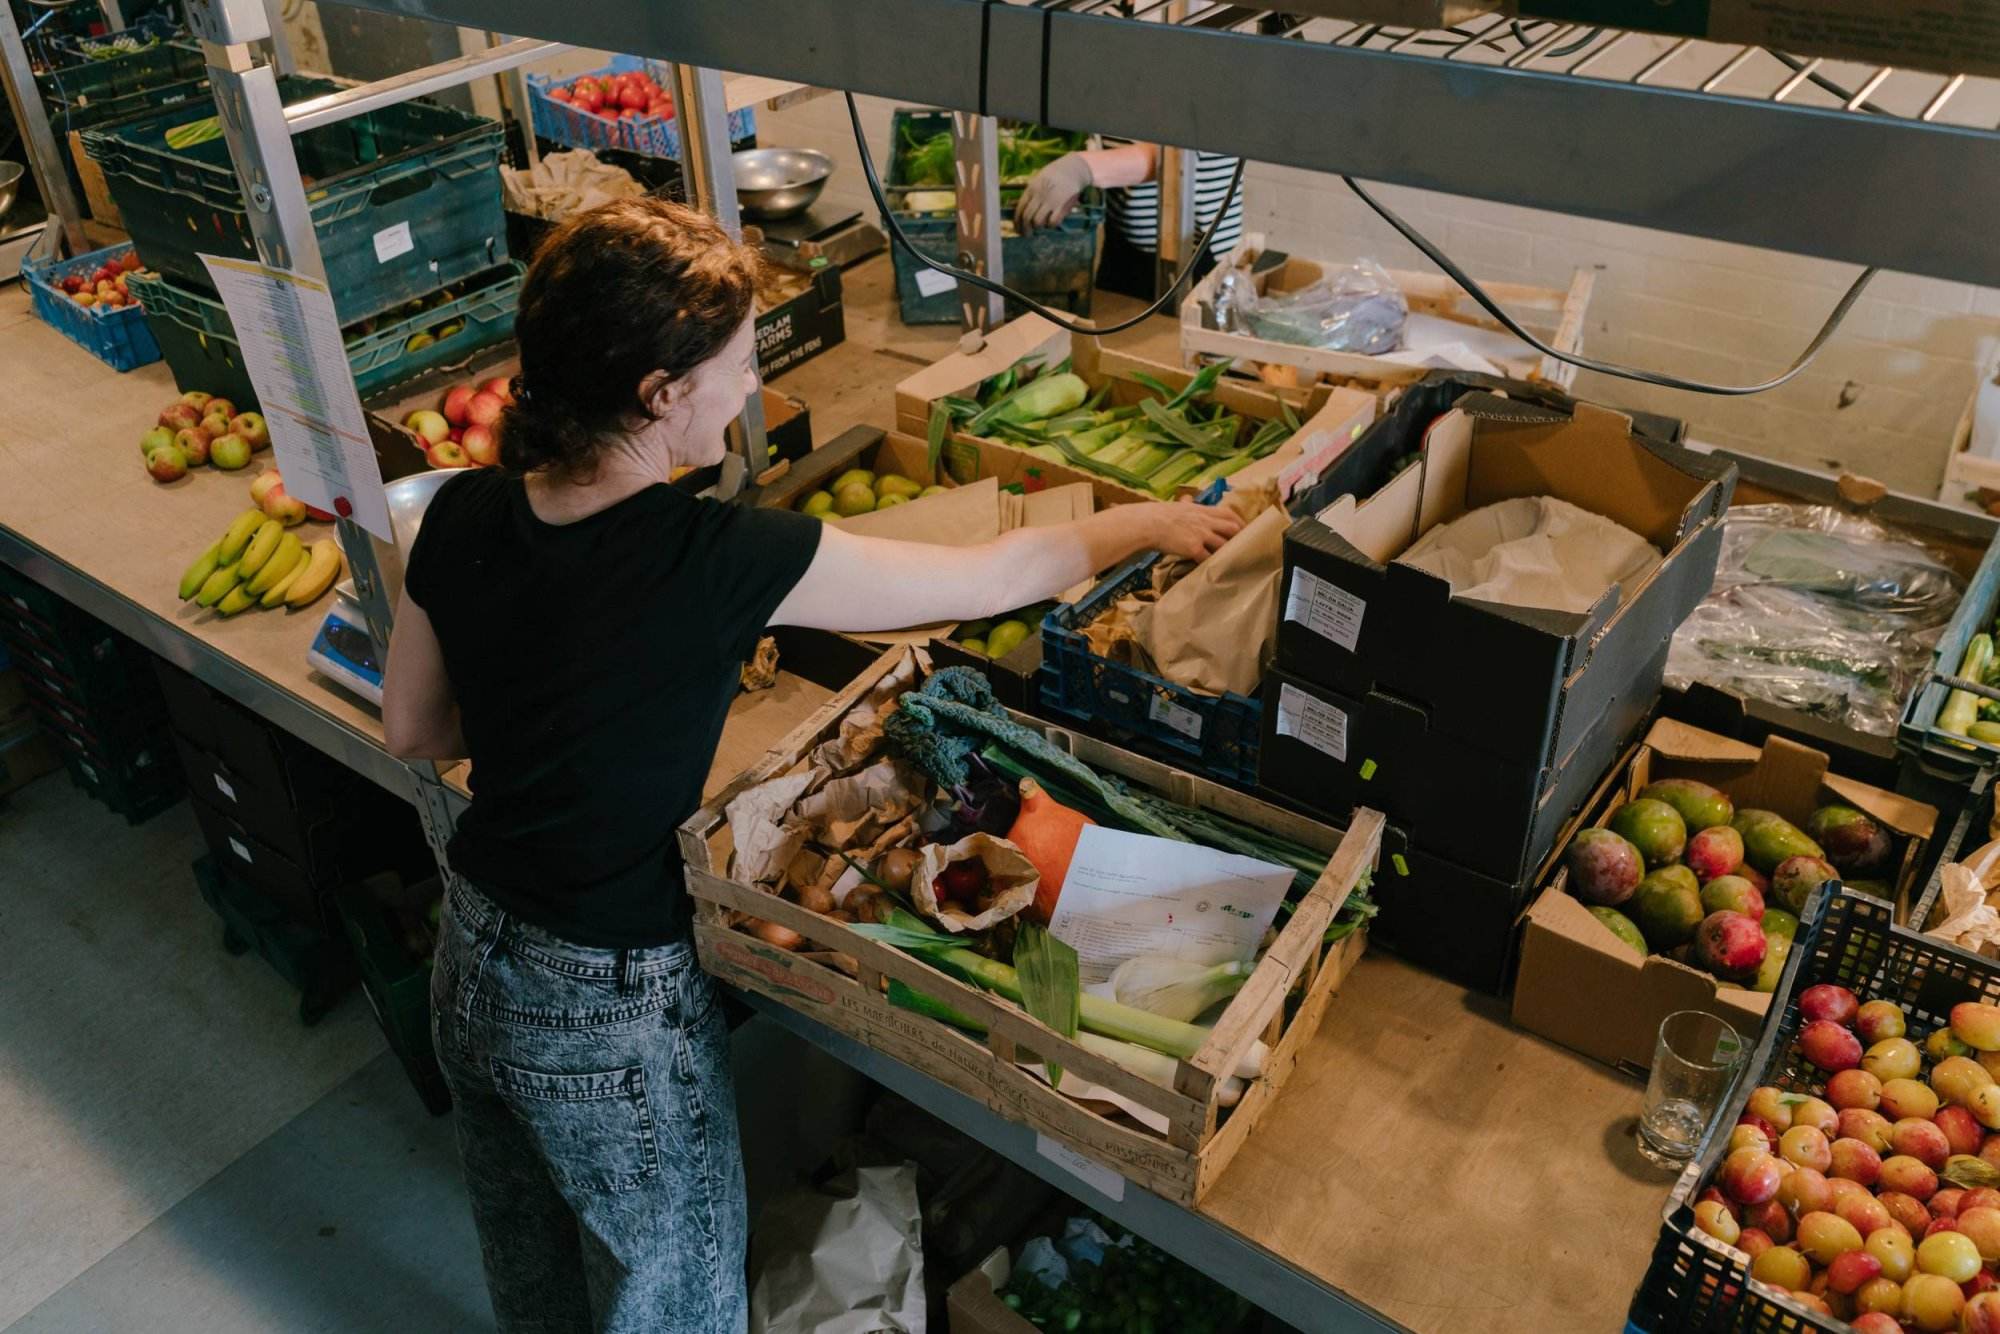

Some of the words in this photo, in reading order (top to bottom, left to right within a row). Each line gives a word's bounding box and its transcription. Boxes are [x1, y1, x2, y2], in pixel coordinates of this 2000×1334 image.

[754, 325, 793, 352] FARMS
[756, 314, 792, 340] EDLAM
[842, 995, 859, 1012] LES
